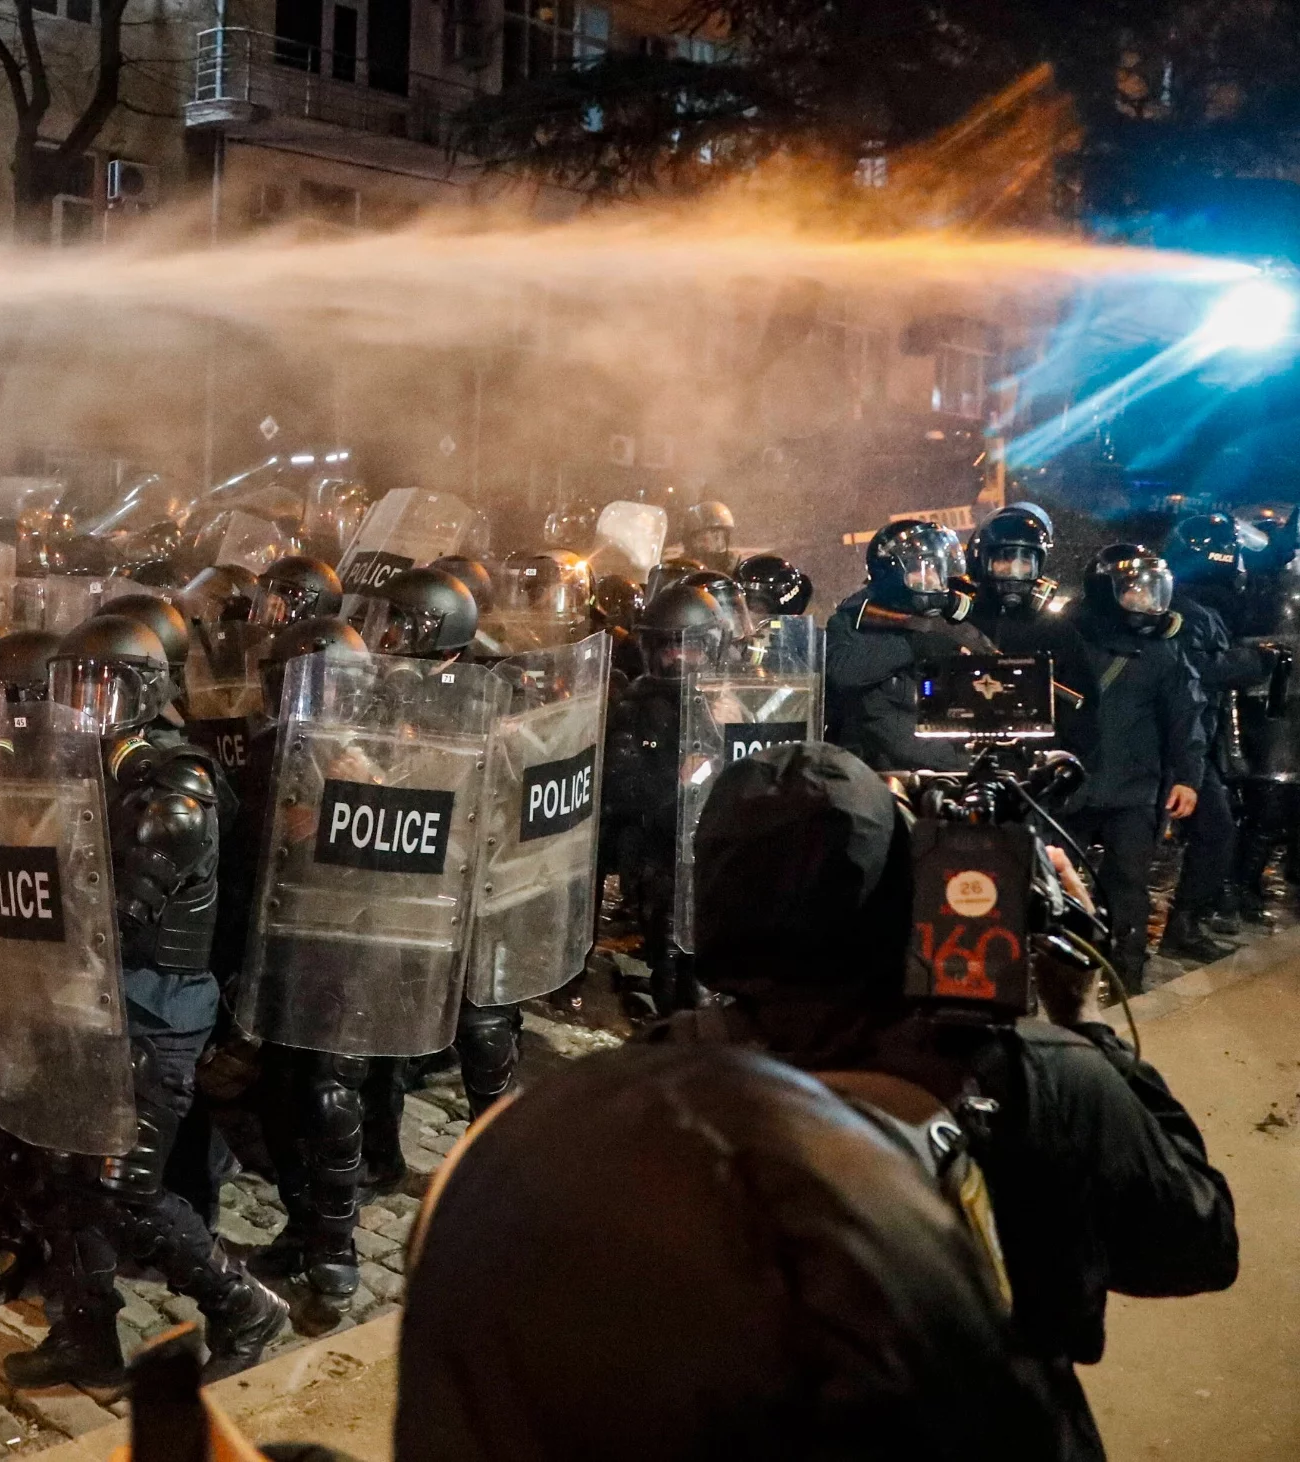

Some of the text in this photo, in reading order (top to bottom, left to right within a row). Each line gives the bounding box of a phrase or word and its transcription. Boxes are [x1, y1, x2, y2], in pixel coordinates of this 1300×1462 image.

[1208, 552, 1234, 563] POLICE
[216, 734, 246, 767] ICE
[528, 765, 591, 822] POLICE
[329, 801, 441, 854] POLICE
[960, 881, 983, 896] 26
